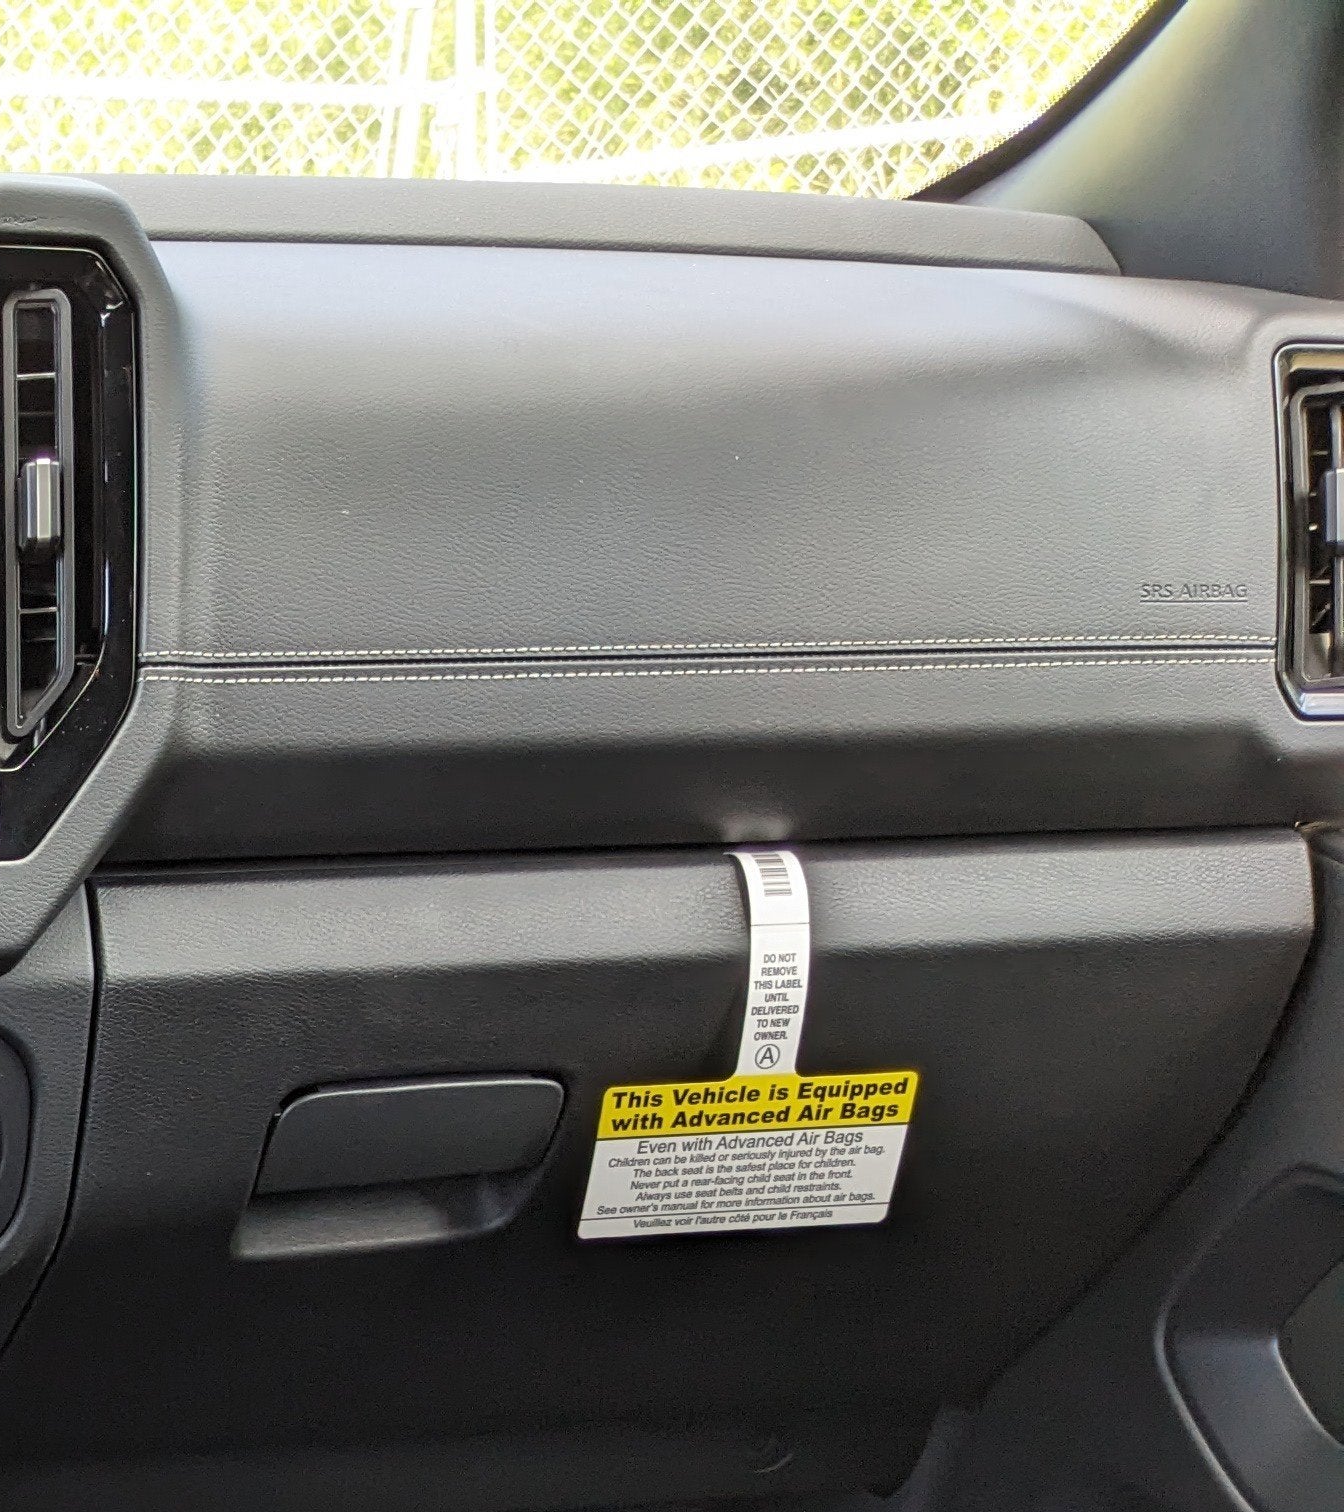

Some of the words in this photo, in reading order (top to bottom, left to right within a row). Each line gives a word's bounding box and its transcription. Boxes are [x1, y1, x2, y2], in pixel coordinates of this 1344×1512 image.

[1140, 583, 1174, 599] SRS
[1180, 583, 1248, 599] AIRBAG
[763, 954, 776, 964] DO
[778, 953, 797, 963] NOT
[761, 966, 798, 977] REMOVE
[754, 980, 773, 990] THIS
[774, 979, 803, 989] LABEL
[764, 993, 789, 1003] UNTIL
[751, 1005, 800, 1016] DELIVERED
[756, 1019, 769, 1028] TO
[769, 1018, 791, 1028] NEW
[759, 1047, 775, 1065] A
[612, 1090, 663, 1109] This
[673, 1085, 760, 1106] Vehicle
[768, 1084, 789, 1101] is
[797, 1077, 909, 1102] Equipped
[612, 1112, 663, 1131] with
[670, 1106, 791, 1128] Advanced
[796, 1104, 834, 1122] Air
[839, 1102, 899, 1122] Bags
[637, 1140, 676, 1154] Even
[682, 1137, 713, 1152] with
[715, 1133, 794, 1150] Advanced
[796, 1132, 821, 1146] Air
[823, 1130, 864, 1147] Bags
[608, 1157, 651, 1168] Children
[652, 1157, 672, 1166] can
[674, 1155, 687, 1164] be
[689, 1153, 716, 1163] killed
[718, 1153, 730, 1161] or
[731, 1150, 776, 1161] seriously
[778, 1148, 813, 1160] injured
[815, 1148, 828, 1158] by
[830, 1146, 846, 1156] the
[848, 1146, 862, 1155] air
[864, 1145, 885, 1156] bag.
[633, 1169, 652, 1178] The
[655, 1167, 680, 1177] back
[681, 1166, 703, 1175] seat
[705, 1165, 714, 1174] is
[716, 1164, 733, 1173] the
[735, 1162, 767, 1172] safest
[768, 1161, 796, 1172] place
[798, 1159, 812, 1169] for
[814, 1158, 856, 1169] children.
[630, 1180, 662, 1190] Never
[662, 1179, 680, 1190] put
[681, 1179, 689, 1188] a
[747, 1173, 772, 1184] child
[773, 1172, 796, 1183] seat
[797, 1172, 807, 1181] in
[809, 1171, 826, 1180] the
[635, 1191, 672, 1202] Always
[674, 1191, 693, 1200] use
[695, 1189, 717, 1198] seat
[719, 1187, 744, 1197] belts
[745, 1185, 766, 1195] and
[767, 1184, 791, 1194] child
[597, 1205, 617, 1216] See
[661, 1201, 699, 1211] manual
[701, 1200, 715, 1210] for
[715, 1200, 742, 1209] more
[745, 1196, 800, 1207] information
[802, 1193, 832, 1204] about
[833, 1192, 848, 1202] air
[674, 1216, 694, 1226] voir
[752, 1213, 777, 1224] pour
[778, 1211, 788, 1221] le
